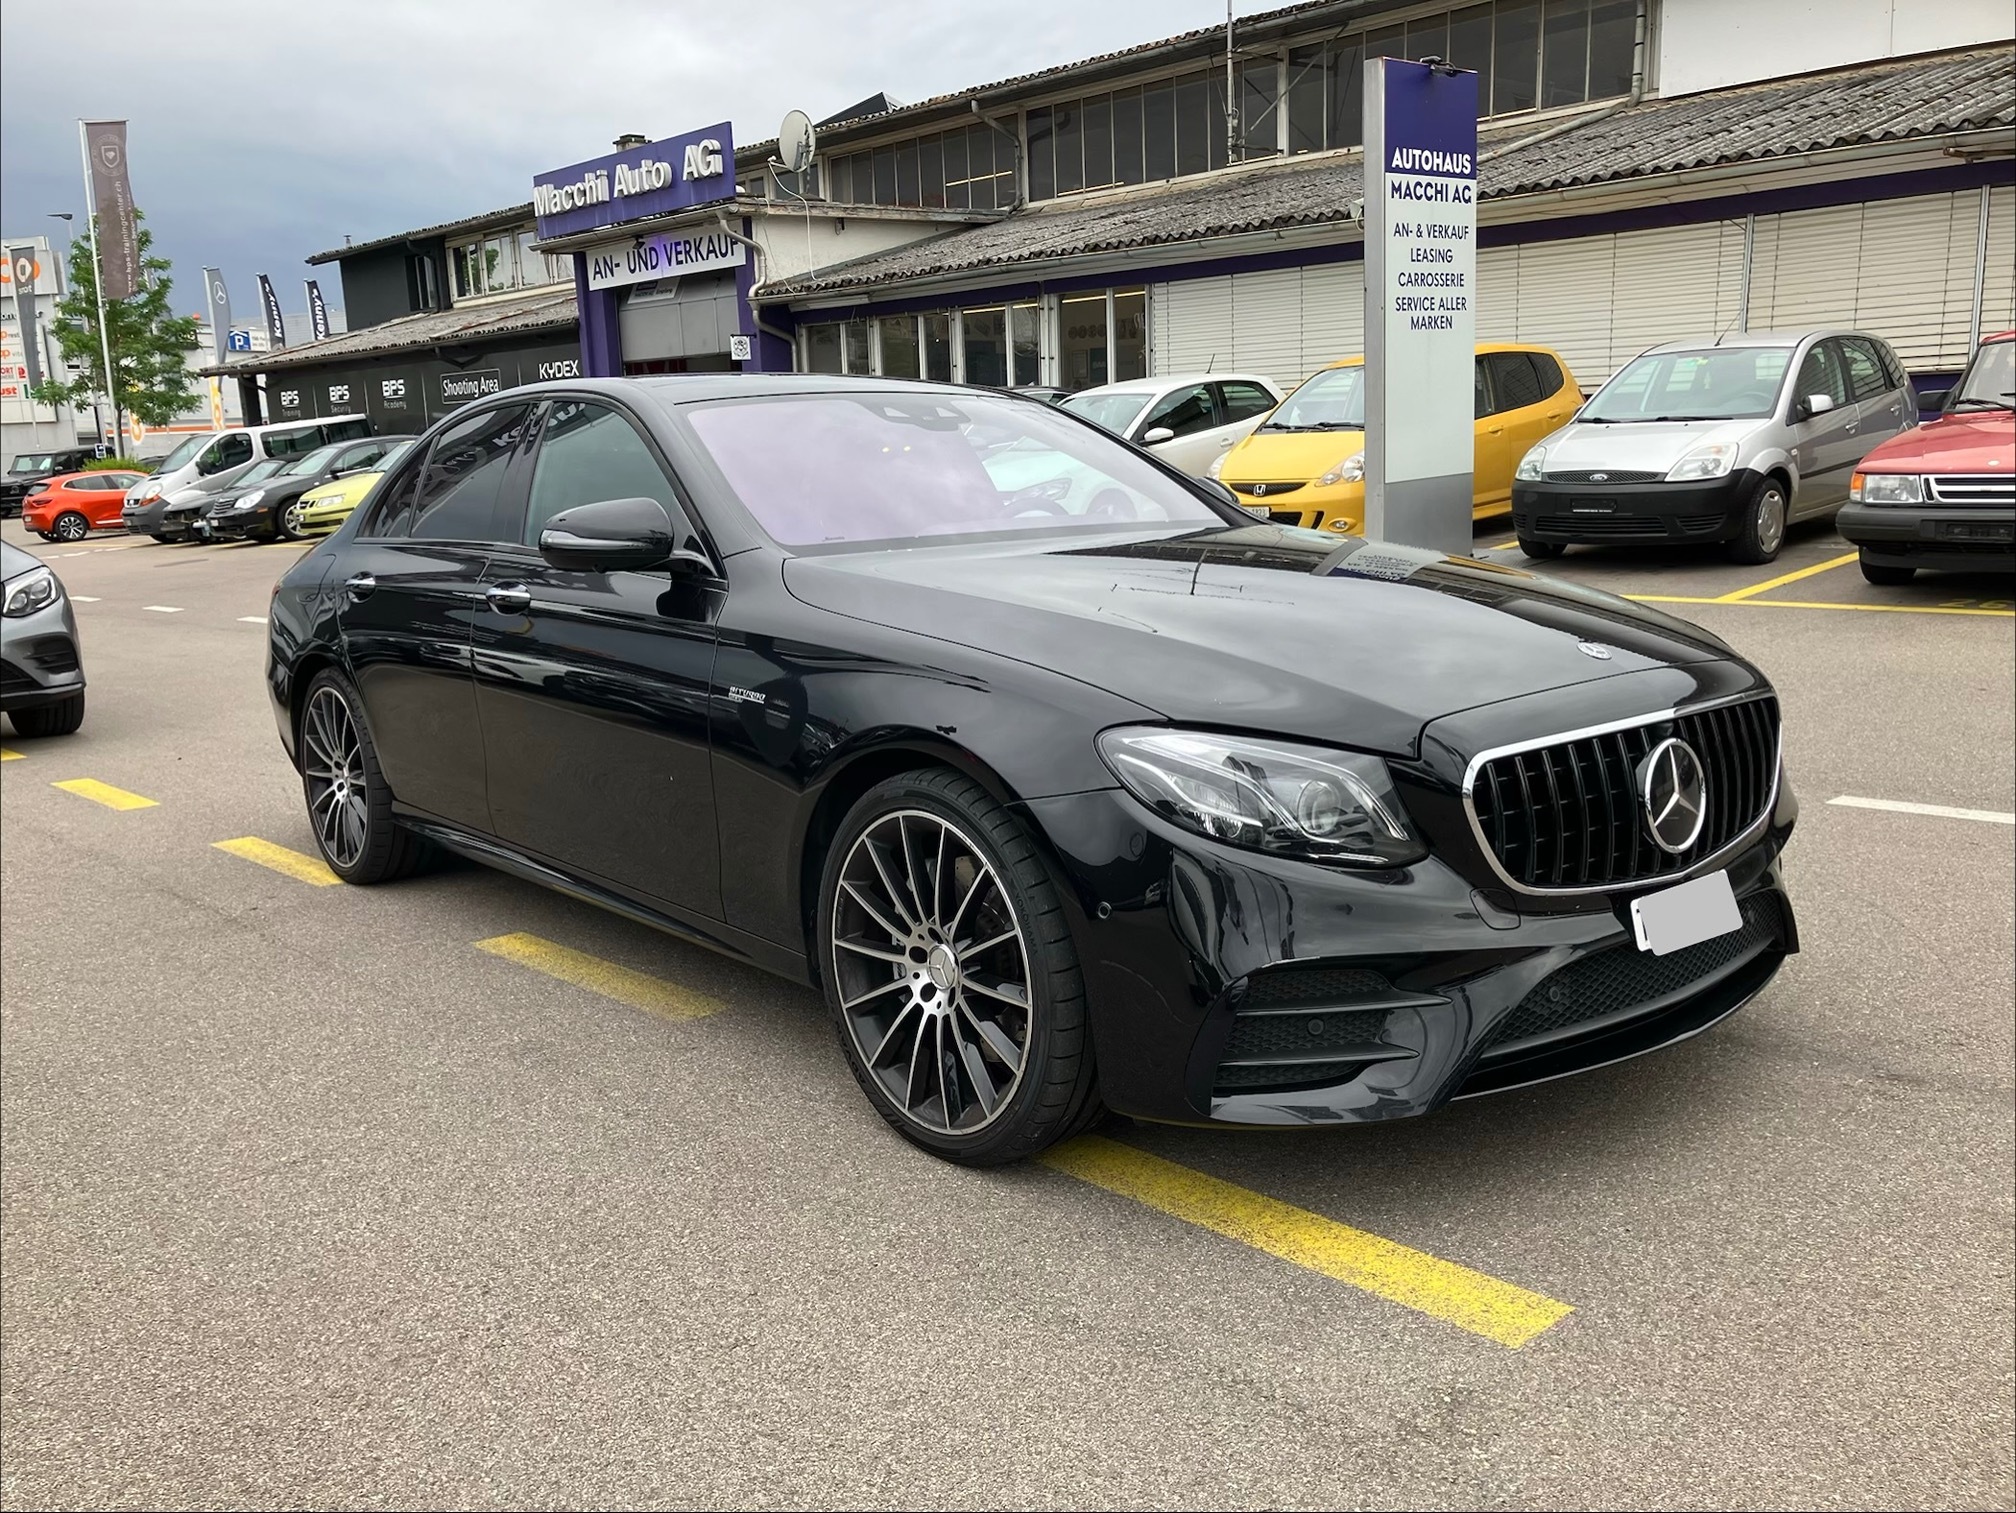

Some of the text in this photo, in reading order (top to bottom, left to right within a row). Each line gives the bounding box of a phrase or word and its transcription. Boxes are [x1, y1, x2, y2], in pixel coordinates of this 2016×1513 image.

[1391, 147, 1472, 175] AUTOHAUS
[533, 139, 723, 217] Macchi Auto AG
[1391, 180, 1472, 204] MACCHI AG
[1393, 223, 1469, 240] AN- & VERKAUF
[593, 254, 621, 281] AN-
[627, 246, 660, 274] UND
[1410, 248, 1453, 263] LEASING
[1398, 272, 1465, 288] CARROSSERIE
[265, 283, 282, 338] Kenny's
[1395, 296, 1467, 311] SERVICE ALLER
[1410, 315, 1453, 330] MARKEN
[538, 359, 580, 380] KYDEX
[329, 385, 350, 401] BPS
[382, 379, 405, 397] BPS
[443, 376, 499, 398] Shooting Area
[280, 390, 299, 406] BPS
